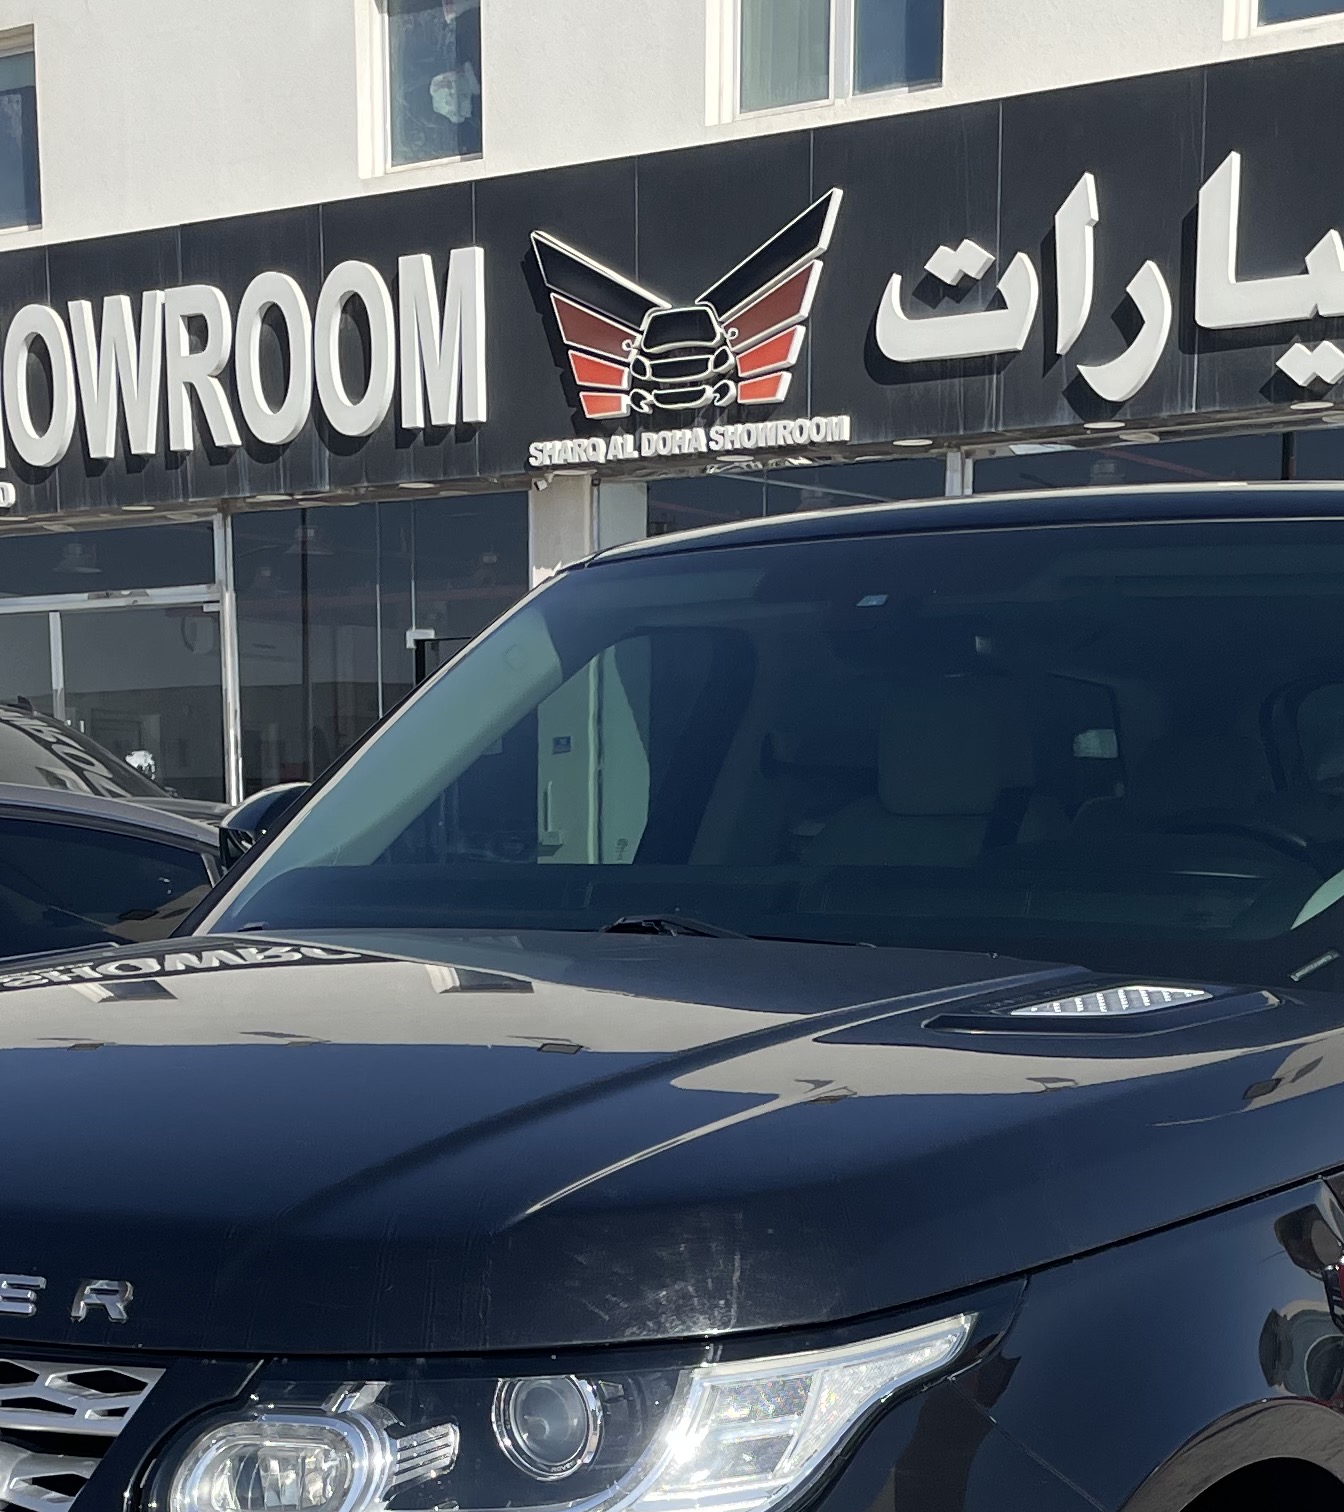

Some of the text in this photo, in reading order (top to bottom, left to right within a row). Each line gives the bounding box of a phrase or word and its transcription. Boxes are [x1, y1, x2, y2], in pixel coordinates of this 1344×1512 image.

[529, 414, 851, 467] SHARQ AL DOHA SHOWROOM
